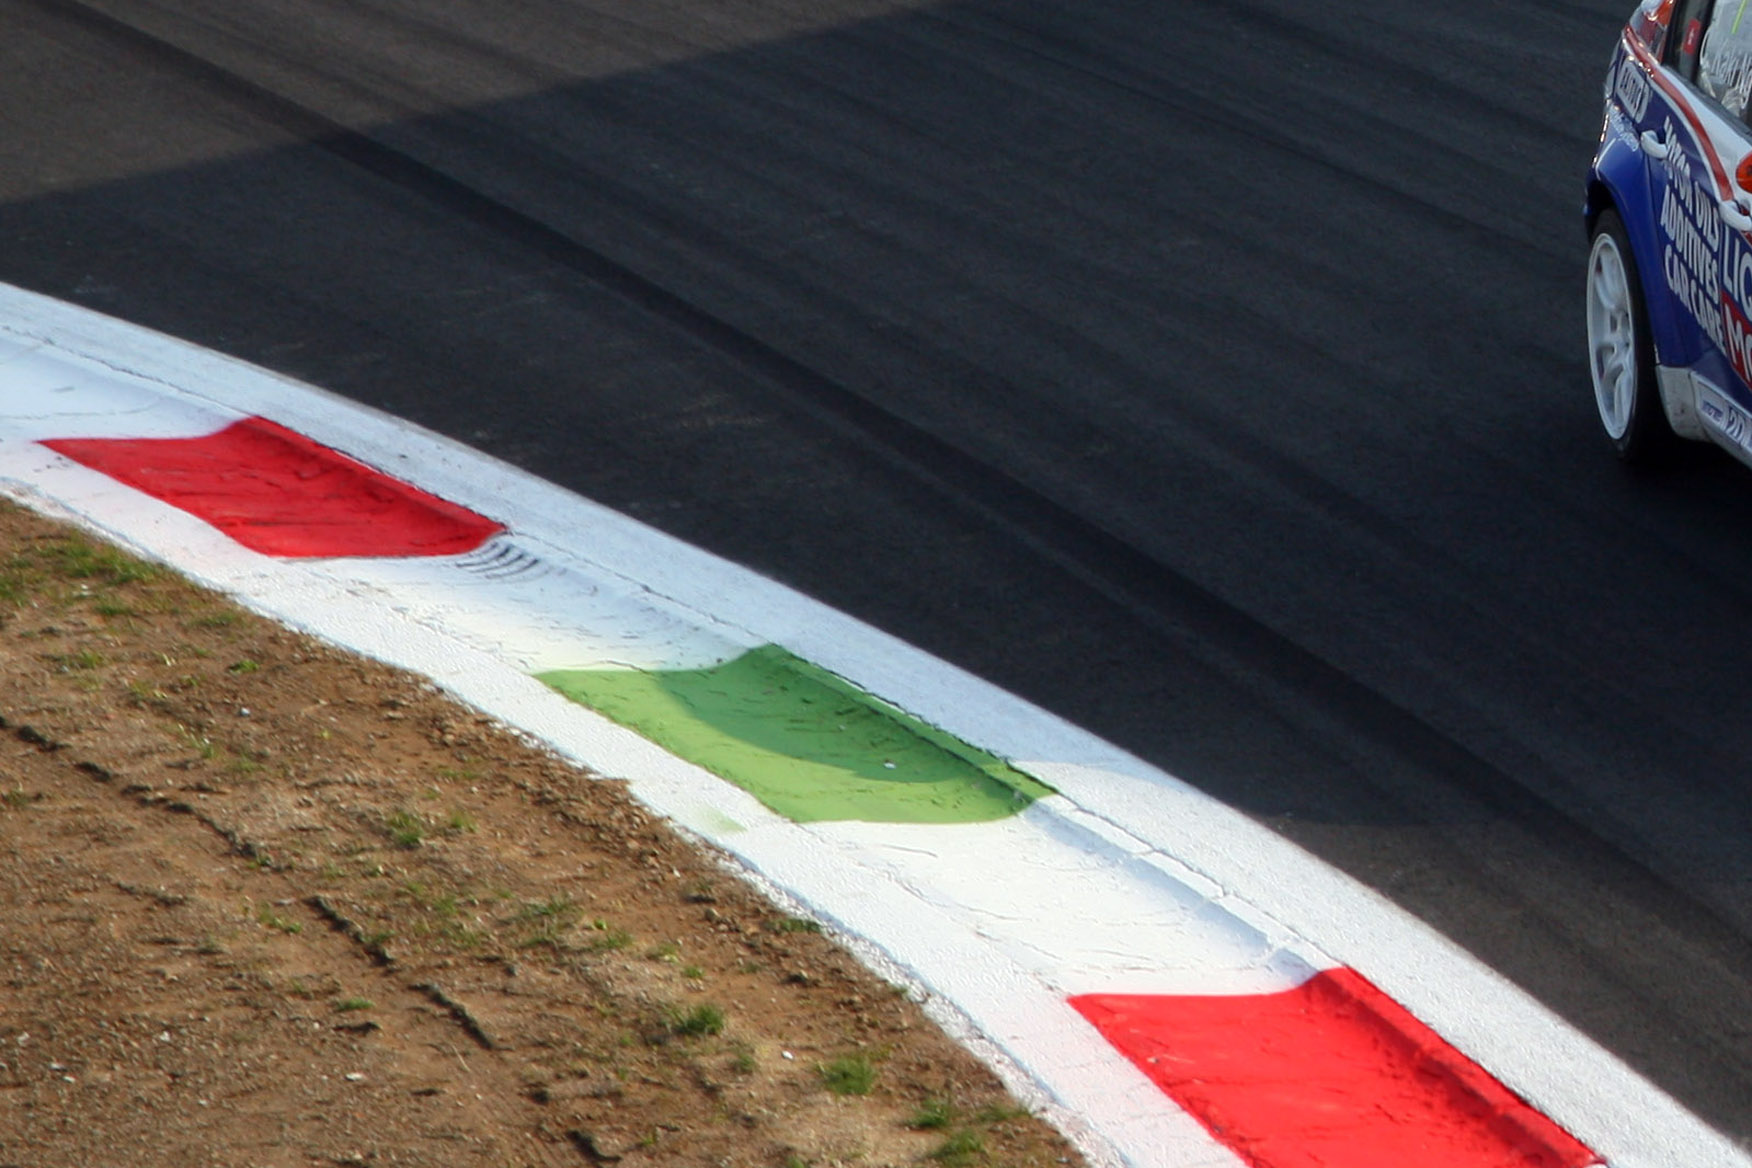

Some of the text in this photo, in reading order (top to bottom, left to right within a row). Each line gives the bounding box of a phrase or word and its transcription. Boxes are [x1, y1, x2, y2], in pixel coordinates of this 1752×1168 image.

[1660, 183, 1720, 305] ADDITIVES
[1694, 180, 1720, 253] OILS
[1665, 243, 1728, 360] CAR CARE
